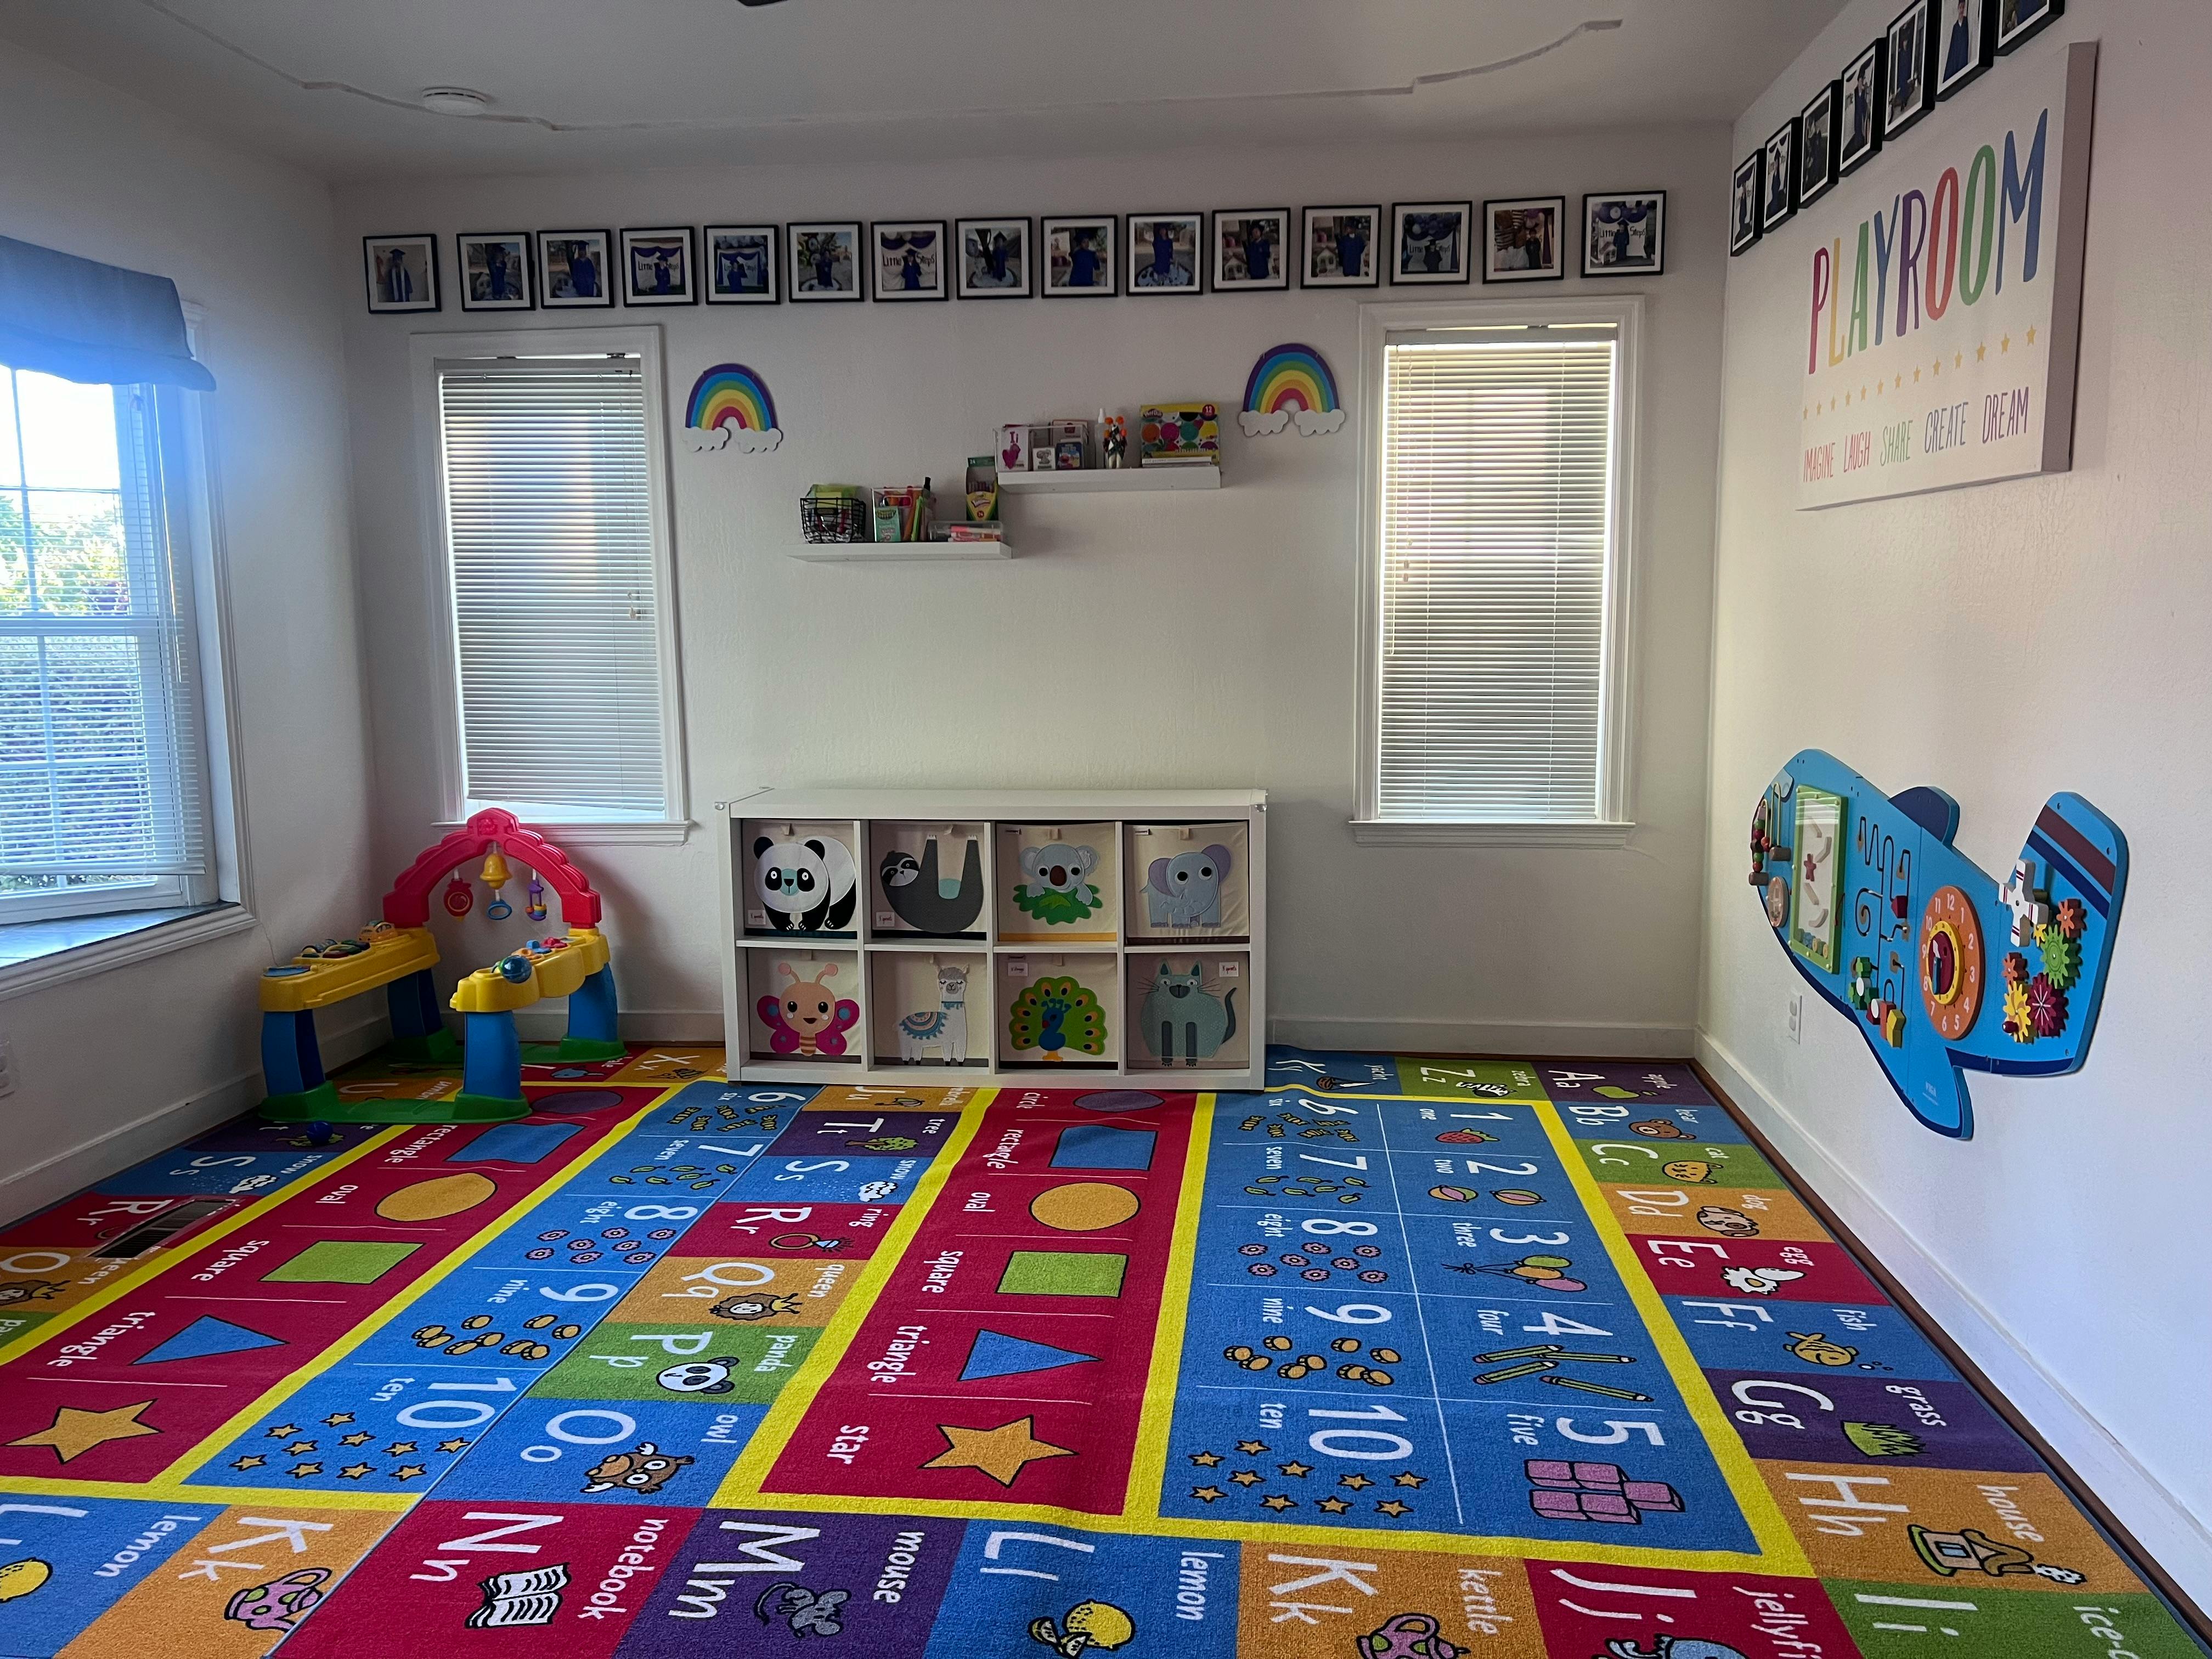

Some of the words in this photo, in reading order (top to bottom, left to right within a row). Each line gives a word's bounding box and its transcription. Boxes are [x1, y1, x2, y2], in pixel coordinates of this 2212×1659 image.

[1808, 108, 2047, 375] PLAYROOM
[1803, 442, 1835, 482] IMAGINE
[1843, 430, 1870, 473] LAUGH
[1880, 419, 1913, 467] SHARE
[1925, 401, 1968, 454] CREATE
[1983, 386, 2029, 444] DREAM
[1935, 897, 1941, 913] 11
[1947, 893, 1955, 911] 12
[1926, 915, 1932, 931] 10
[1961, 907, 1964, 924] 1
[1922, 944, 1927, 959] 9
[1968, 933, 1973, 950] 2
[1923, 975, 1928, 991] 8
[1970, 966, 1975, 983] 3
[1931, 1001, 1936, 1016] 7
[1963, 996, 1970, 1013] 4
[1942, 1015, 1947, 1031] 6
[1954, 1014, 1960, 1030] 5
[1511, 1070, 1536, 1086] zebra
[718, 1092, 742, 1101] six
[748, 1092, 806, 1102] 6
[1016, 1092, 1049, 1109] circle
[1268, 1098, 1290, 1107] six
[1298, 1098, 1358, 1115] 6
[1419, 1108, 1437, 1120] one
[1450, 1111, 1514, 1120] 1
[1675, 1108, 1699, 1125] bear
[922, 1118, 945, 1135] tree
[385, 1125, 458, 1164] rectangle
[654, 1139, 690, 1161] seven
[698, 1144, 764, 1157] 7
[982, 1128, 1024, 1170] rectangle
[1704, 1147, 1730, 1160] cat
[281, 1154, 323, 1175] snow
[1266, 1147, 1283, 1170] seven
[1299, 1154, 1368, 1171] 7
[1434, 1159, 1453, 1173] two
[1466, 1160, 1538, 1175] 2
[889, 1159, 917, 1180] snow
[315, 1184, 358, 1204] oval
[962, 1192, 996, 1212] oval
[1741, 1194, 1773, 1211] dog
[580, 1200, 622, 1224] eight
[624, 1204, 698, 1221] 8
[848, 1207, 889, 1228] ring
[1256, 1213, 1294, 1237] eight
[1301, 1218, 1378, 1235] 8
[1452, 1222, 1482, 1248] three
[1489, 1227, 1570, 1245] 3
[191, 1239, 270, 1282] square
[1780, 1246, 1815, 1267] egg
[807, 1263, 844, 1298] queen
[921, 1250, 964, 1294] square
[487, 1279, 529, 1304] nine
[539, 1283, 619, 1302] 9
[1263, 1297, 1294, 1324] nine
[1305, 1304, 1392, 1324] 9
[1832, 1308, 1878, 1331] fish
[1477, 1310, 1510, 1335] four
[1523, 1312, 1613, 1335] 4
[47, 1312, 155, 1367] triangle
[754, 1335, 798, 1373] panda
[867, 1325, 930, 1384] triangle
[369, 1378, 416, 1402] ten
[396, 1377, 518, 1429] 10
[1886, 1385, 1948, 1427] grass
[1260, 1403, 1286, 1429] ten
[701, 1414, 738, 1444] owl
[1308, 1405, 1414, 1460] 10
[1506, 1414, 1545, 1446] five
[1556, 1417, 1666, 1446] 5
[827, 1425, 870, 1465] star
[1977, 1485, 2044, 1543] house
[93, 1514, 202, 1577] lemon
[577, 1519, 669, 1620] notebook
[873, 1531, 925, 1604] mouse
[1176, 1550, 1226, 1621] lemon
[1458, 1568, 1513, 1635] kettle
[1732, 1586, 1822, 1659] jellyfi
[2073, 1606, 2140, 1659] ice-c
